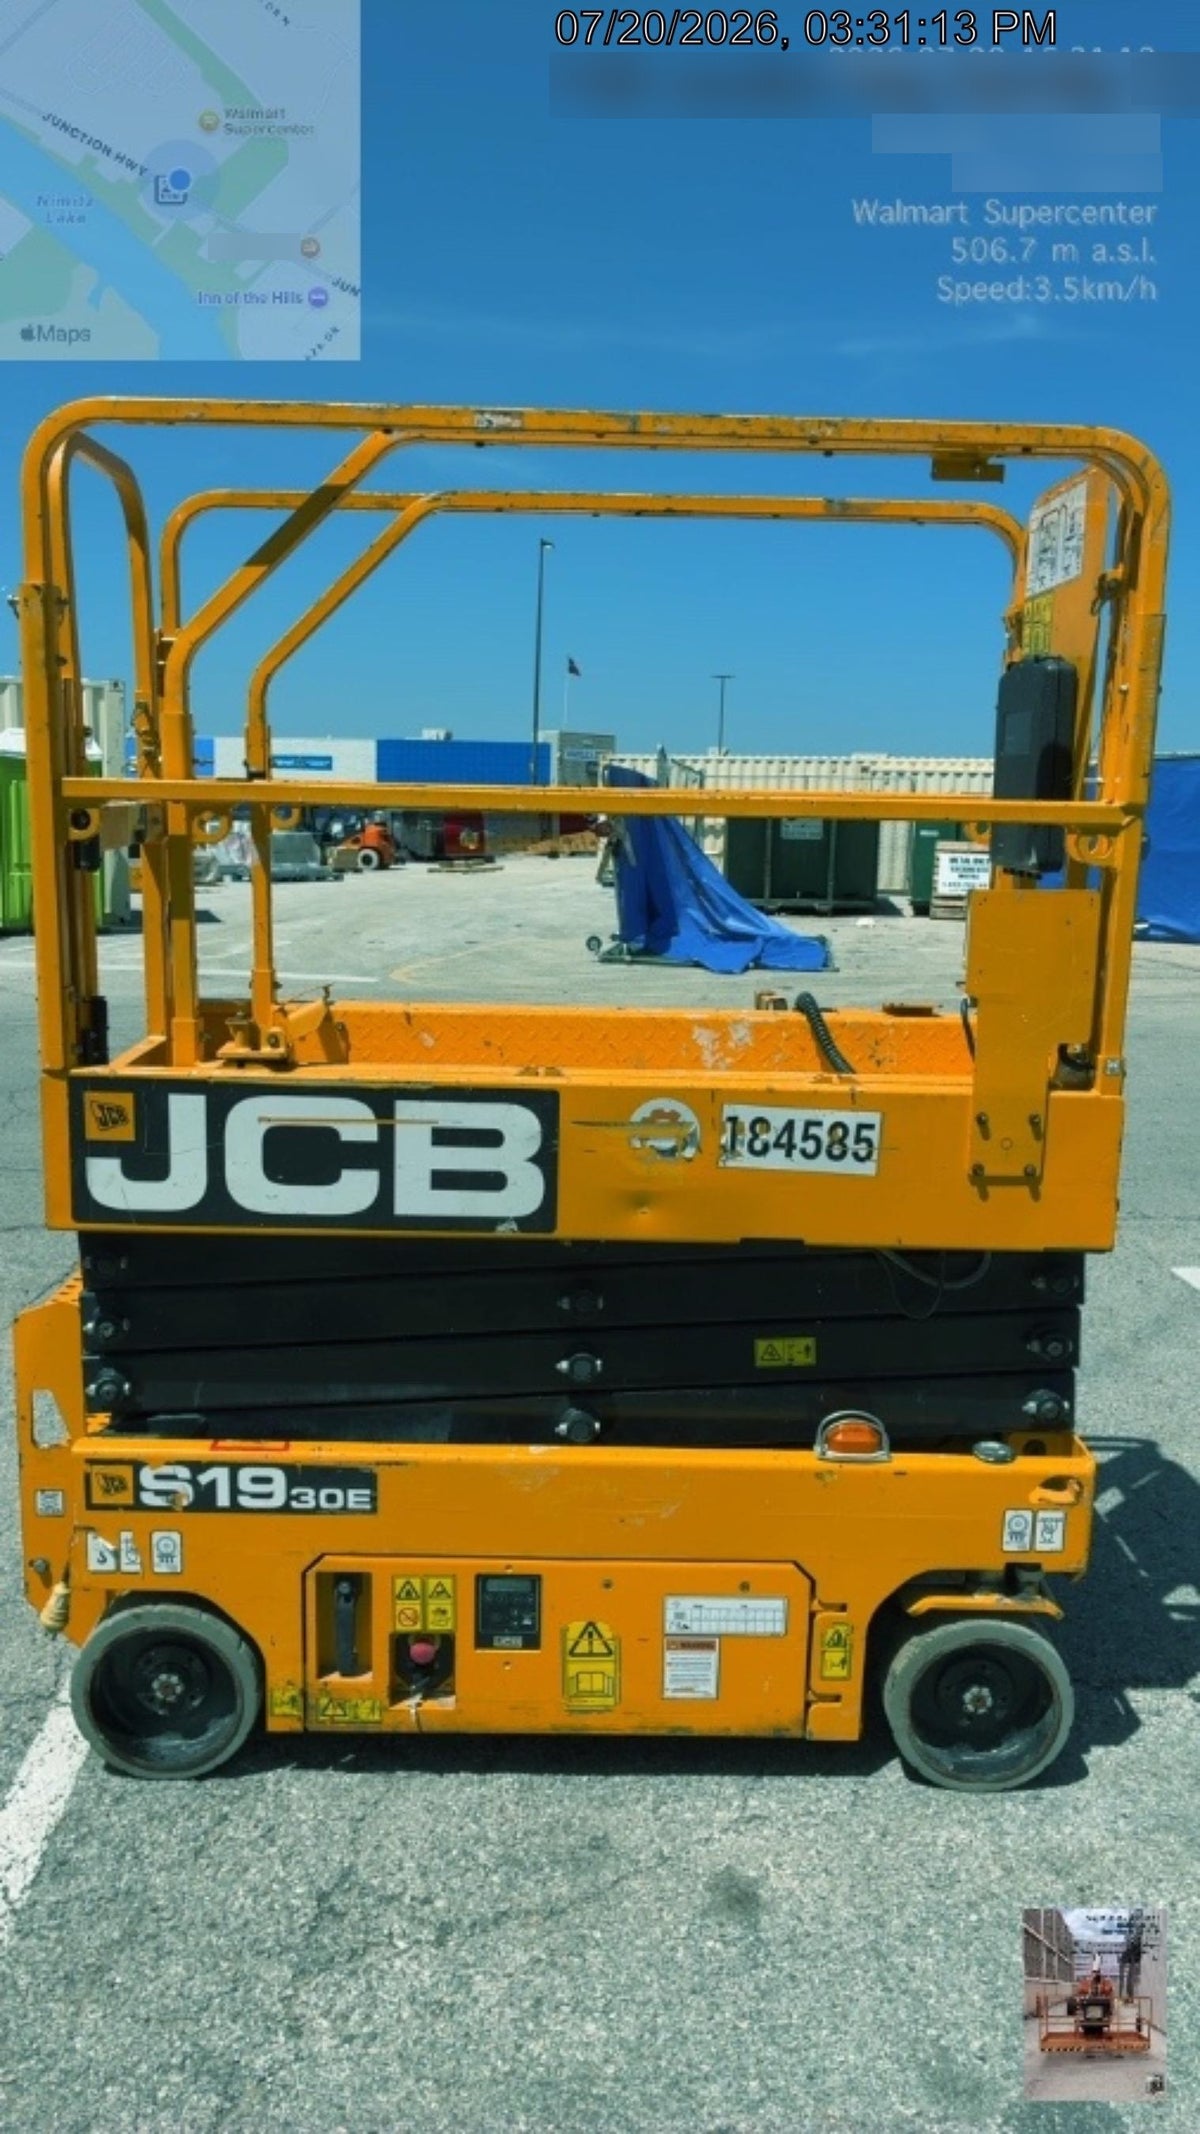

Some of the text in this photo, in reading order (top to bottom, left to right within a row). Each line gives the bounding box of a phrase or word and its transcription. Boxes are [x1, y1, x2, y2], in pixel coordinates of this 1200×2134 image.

[96, 1102, 130, 1129] JCB
[85, 1092, 545, 1218] JCB
[725, 1116, 876, 1163] 184585
